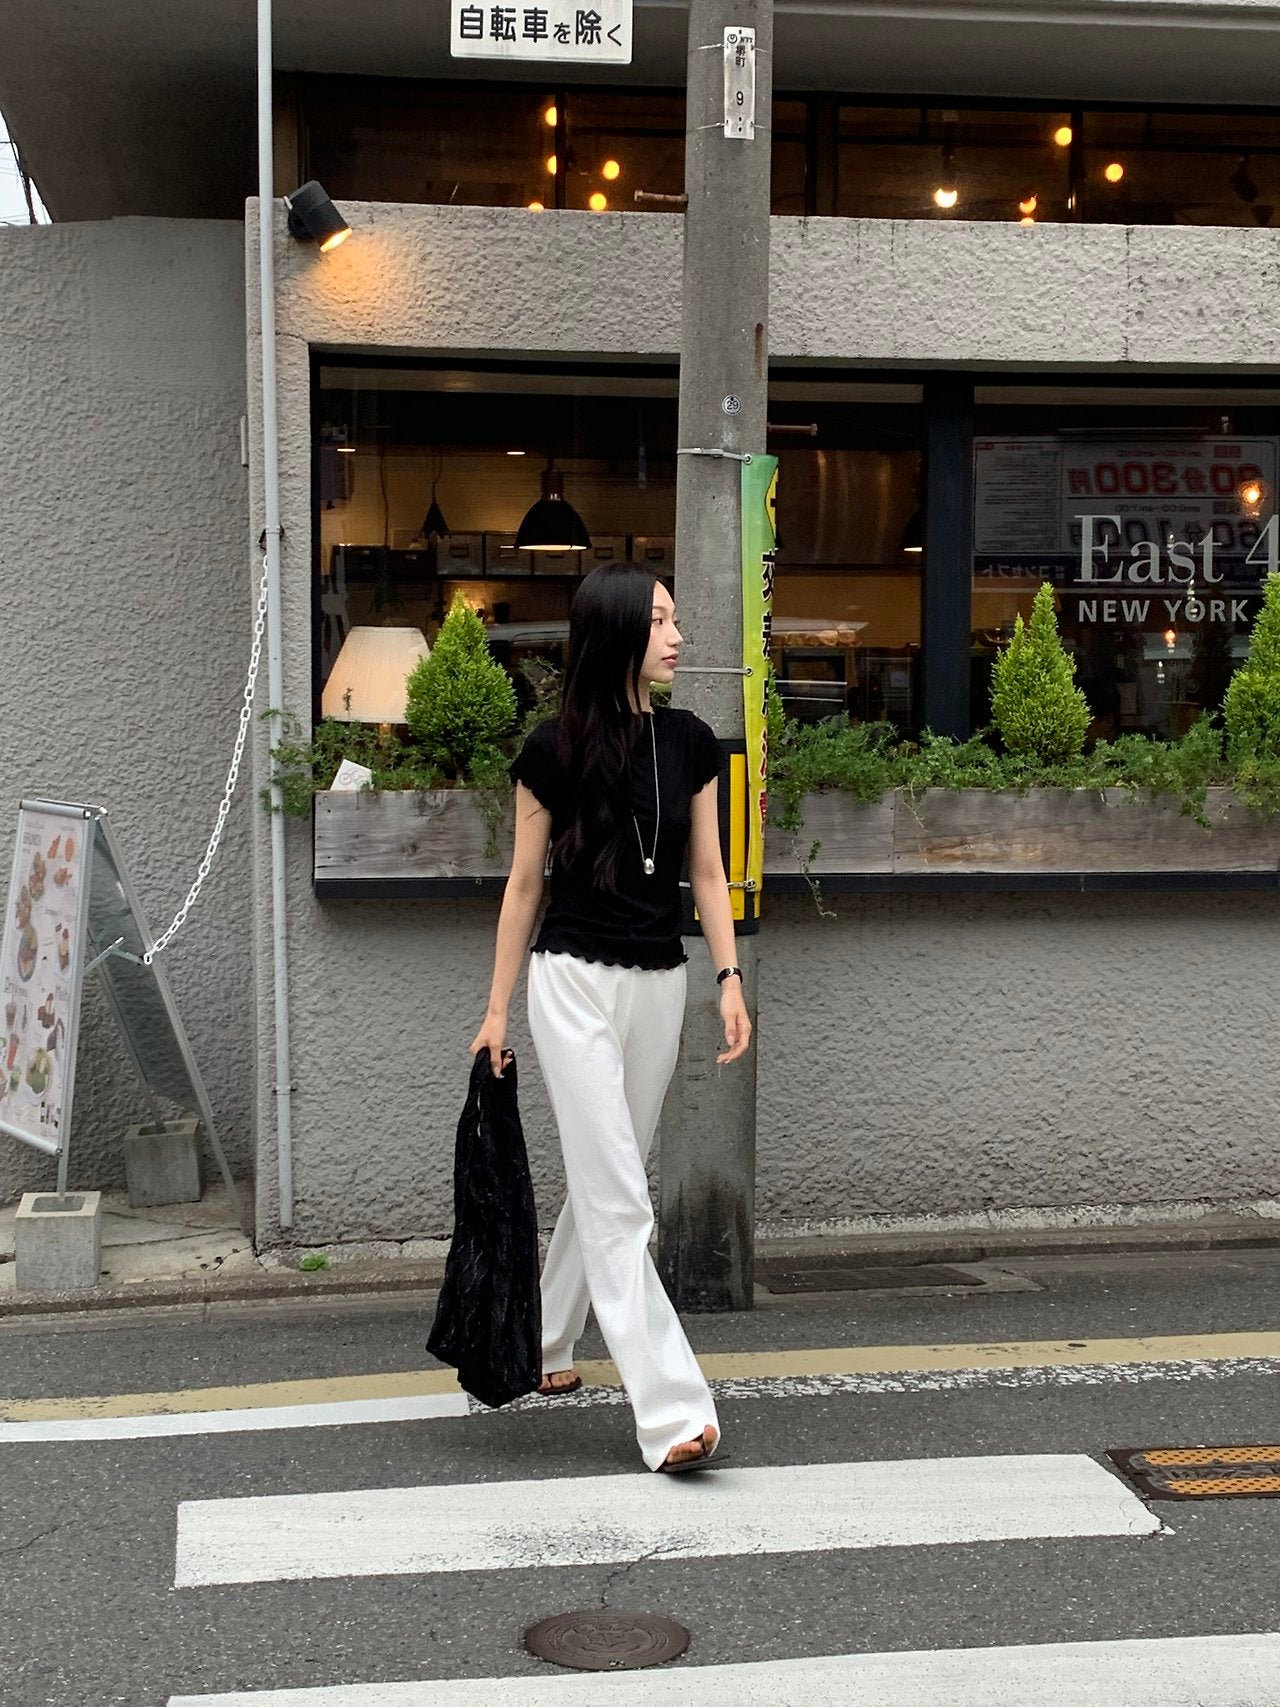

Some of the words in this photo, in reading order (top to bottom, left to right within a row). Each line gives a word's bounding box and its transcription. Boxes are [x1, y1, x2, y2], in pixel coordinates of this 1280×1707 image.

[459, 5, 623, 47] 自転車を除く
[736, 91, 744, 105] 9
[726, 400, 739, 410] 29
[1073, 514, 1224, 583] East
[1245, 513, 1280, 582] 4
[1078, 600, 1150, 622] NEW
[1163, 600, 1249, 622] YORK
